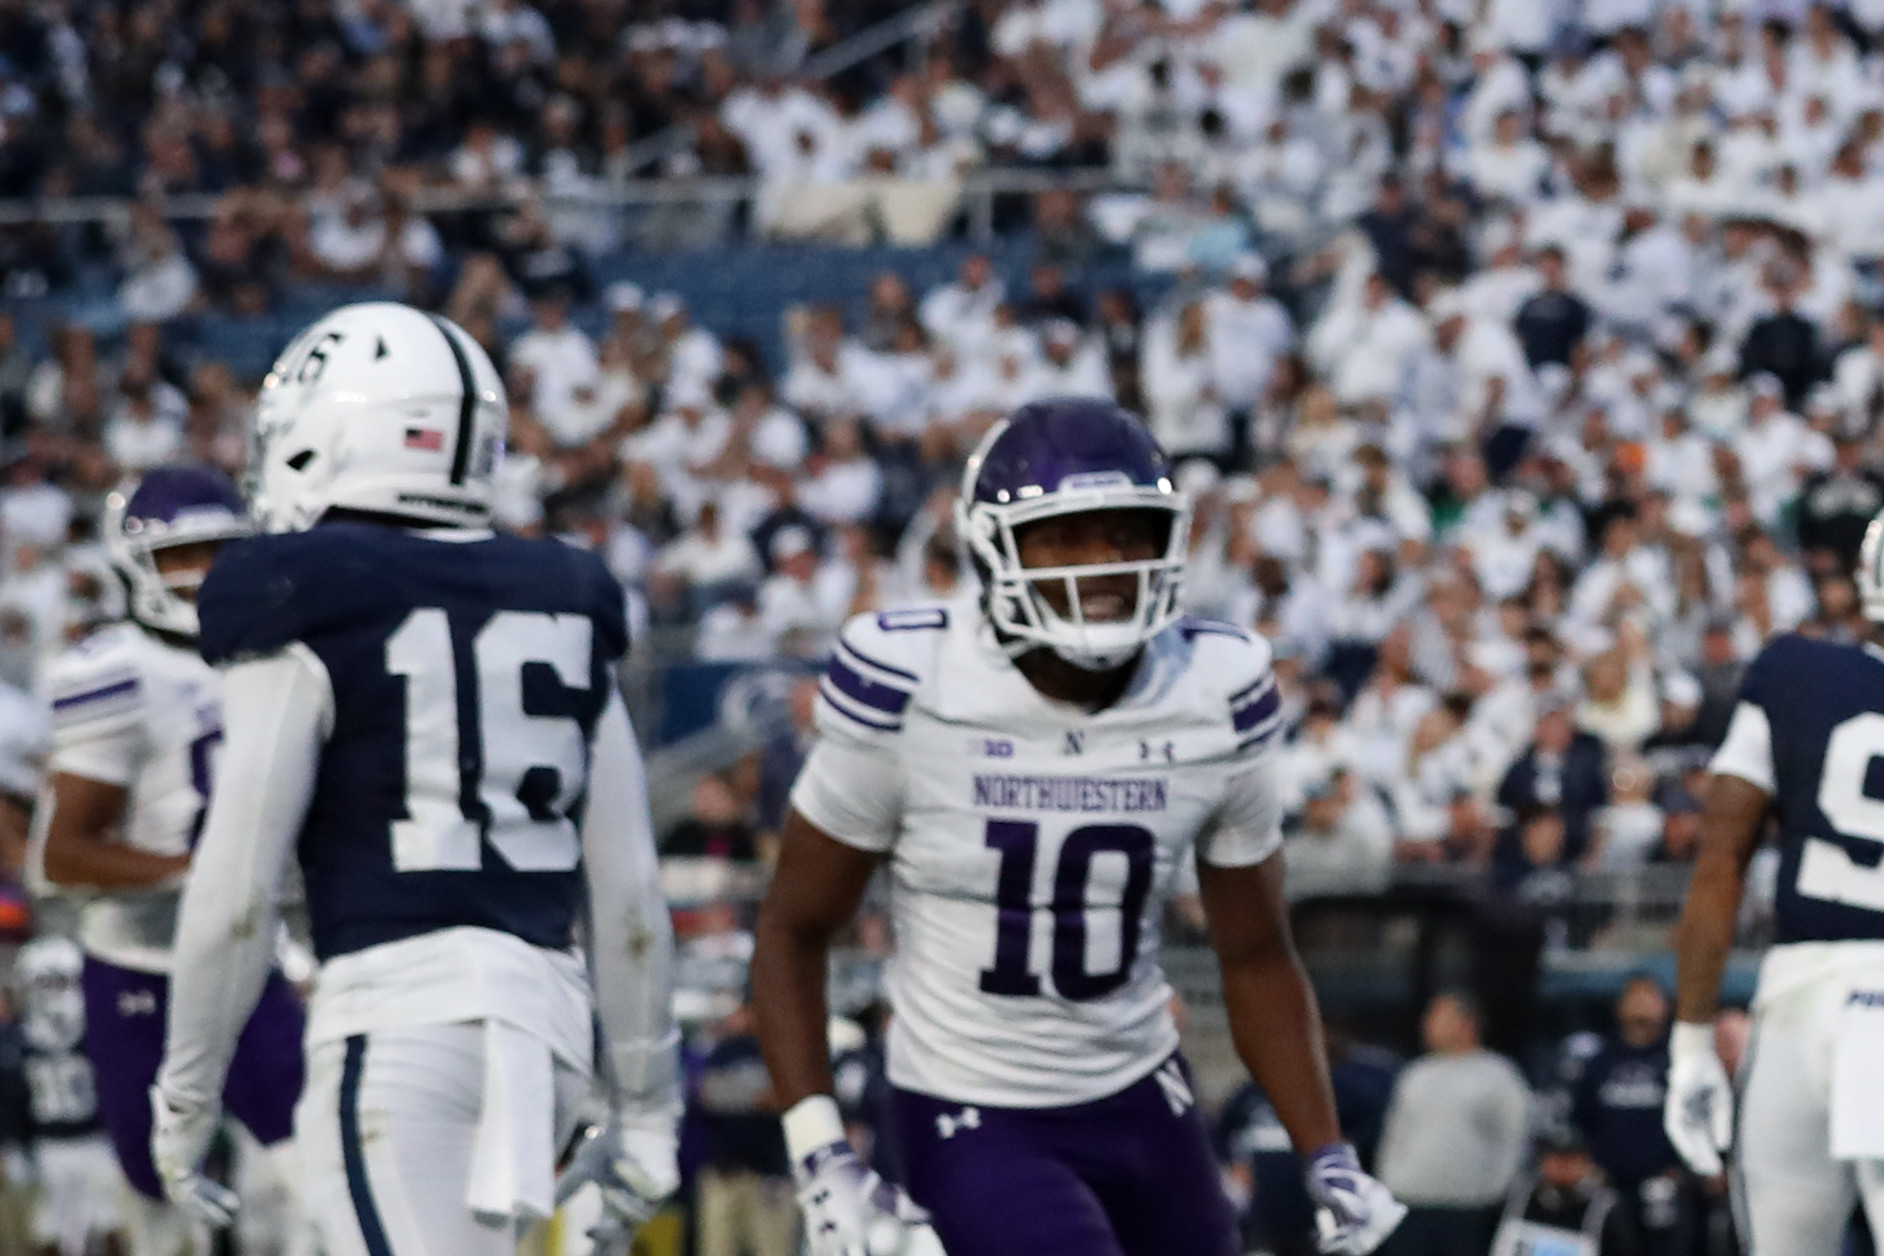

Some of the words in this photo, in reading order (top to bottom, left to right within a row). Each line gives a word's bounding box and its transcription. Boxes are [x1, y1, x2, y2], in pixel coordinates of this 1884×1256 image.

[385, 607, 594, 872] 16
[973, 774, 1168, 811] NORTHWESTERN
[1064, 728, 1085, 755] N
[980, 819, 1156, 1000] 10
